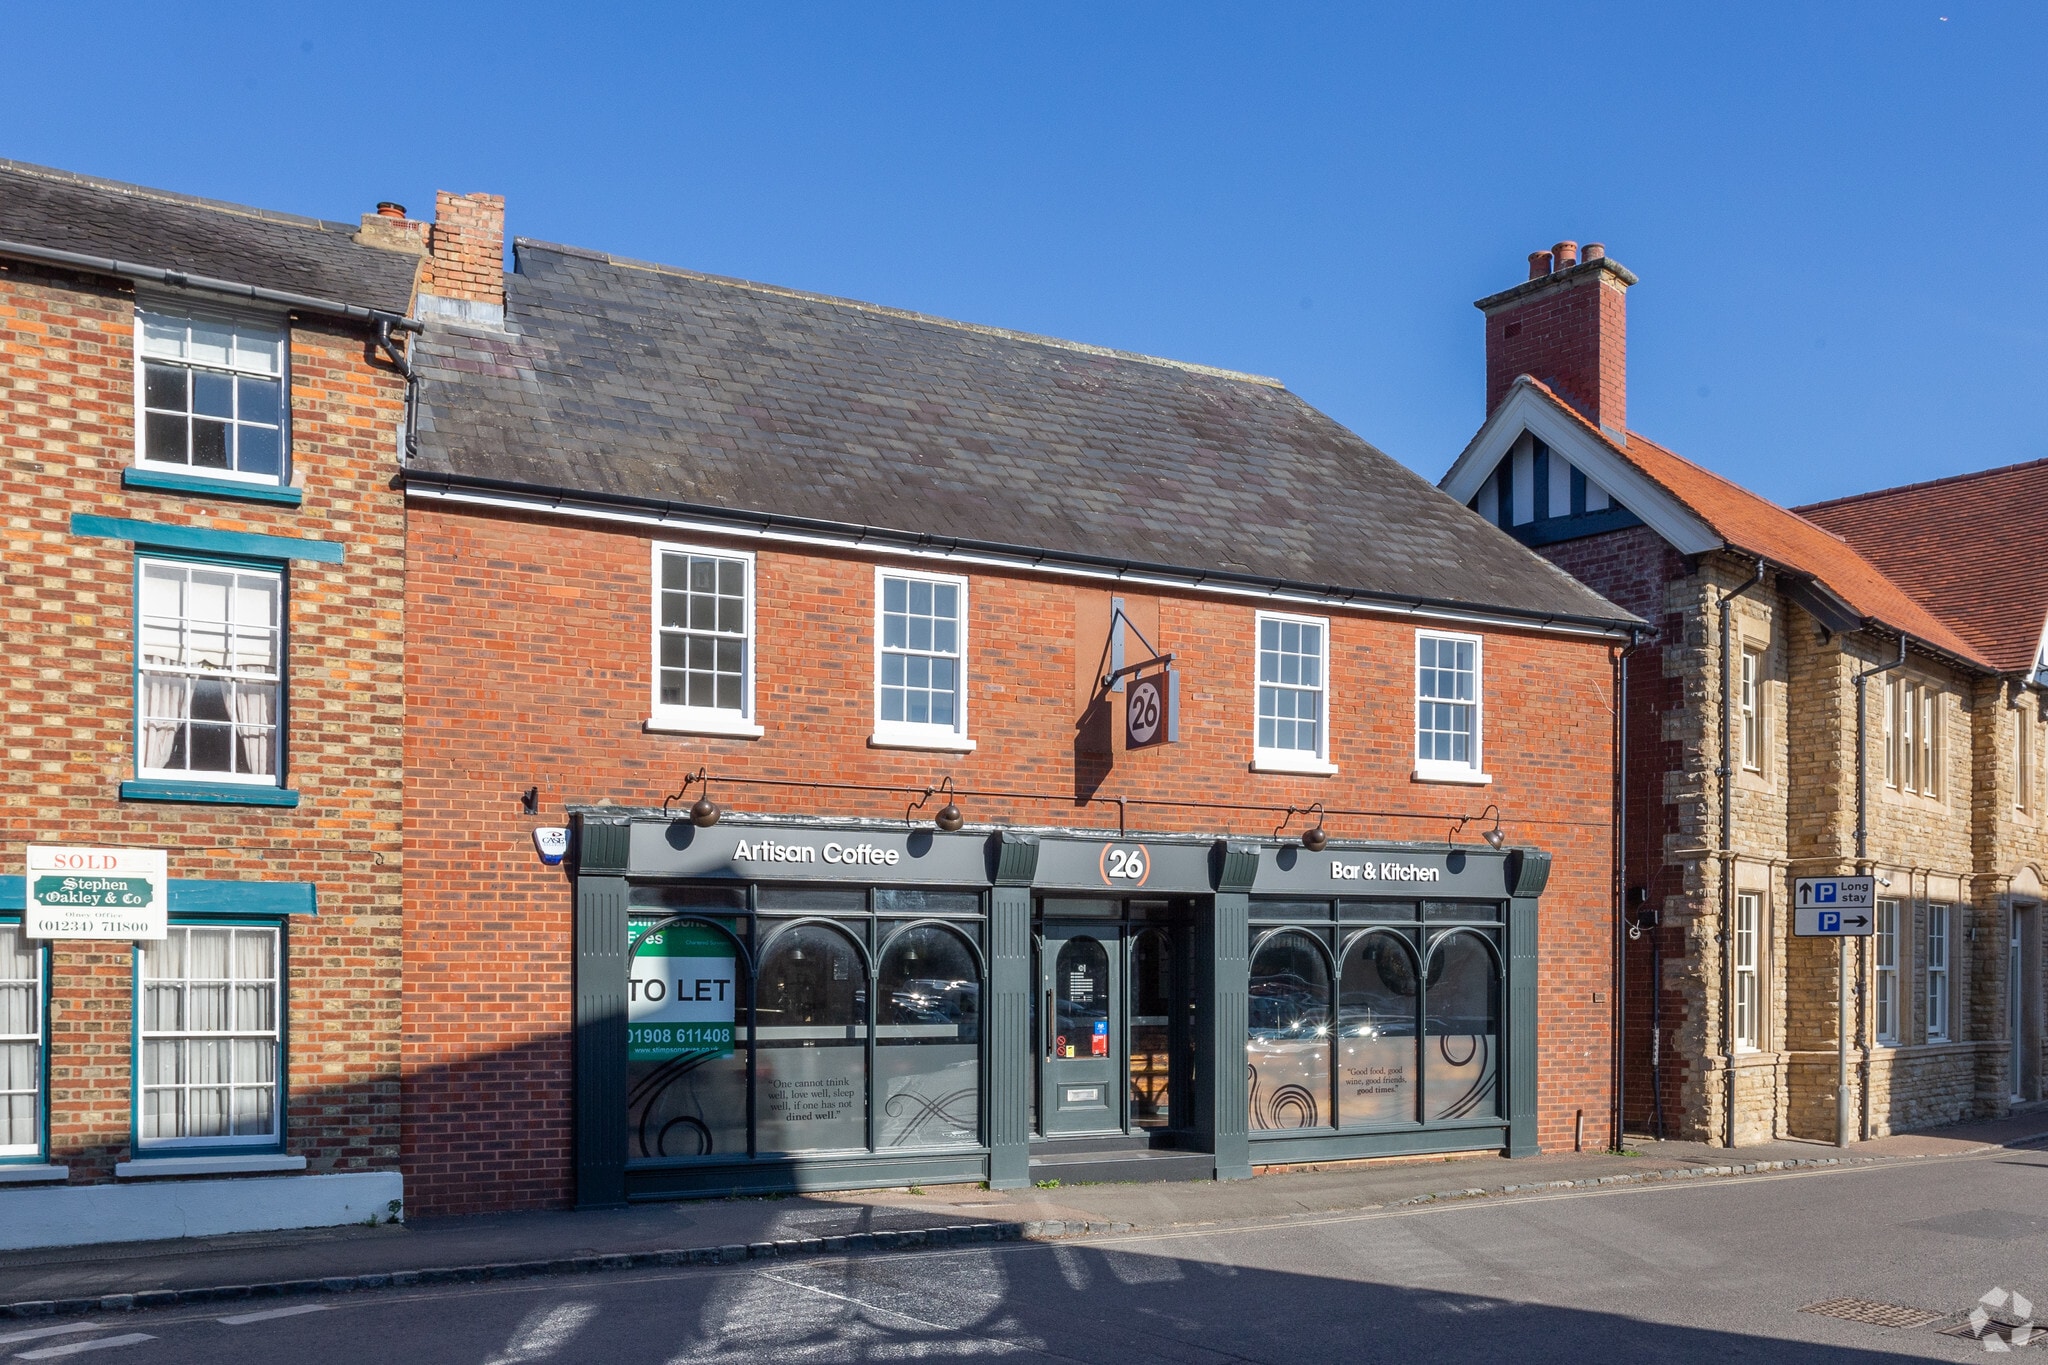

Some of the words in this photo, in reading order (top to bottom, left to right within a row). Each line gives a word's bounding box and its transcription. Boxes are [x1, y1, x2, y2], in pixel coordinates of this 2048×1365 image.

[1132, 691, 1158, 731] 26
[733, 839, 816, 863] Artisan
[822, 842, 900, 866] Coffee
[54, 854, 118, 870] SOLD
[1331, 861, 1360, 880] Bar
[1362, 862, 1377, 880] &
[1380, 862, 1440, 882] Kitchen
[60, 877, 129, 891] Stephen
[1820, 884, 1834, 901] P
[1841, 881, 1869, 892] Long
[46, 891, 101, 906] Oakley
[104, 891, 118, 904] &
[122, 893, 142, 904] Co
[1842, 893, 1867, 903] stay
[65, 911, 91, 919] Olney
[1823, 913, 1838, 930] P
[38, 920, 94, 932] (01234)
[101, 921, 149, 932] 711800
[628, 930, 664, 945] Ees
[628, 978, 666, 1002] TO
[677, 978, 731, 1002] LET
[676, 1028, 730, 1043] 611408
[1388, 1066, 1403, 1075] good
[794, 1079, 824, 1088] cannot
[826, 1077, 850, 1087] think
[1365, 1076, 1381, 1086] good
[768, 1090, 788, 1100] well,
[791, 1089, 808, 1098] love
[811, 1088, 831, 1098] well,
[833, 1087, 855, 1099] sleep
[1356, 1086, 1373, 1096] good
[770, 1101, 791, 1111] well,
[794, 1100, 801, 1110] if
[802, 1102, 819, 1110] one
[821, 1099, 836, 1109] has
[838, 1099, 852, 1108] not
[786, 1111, 812, 1121] dined
